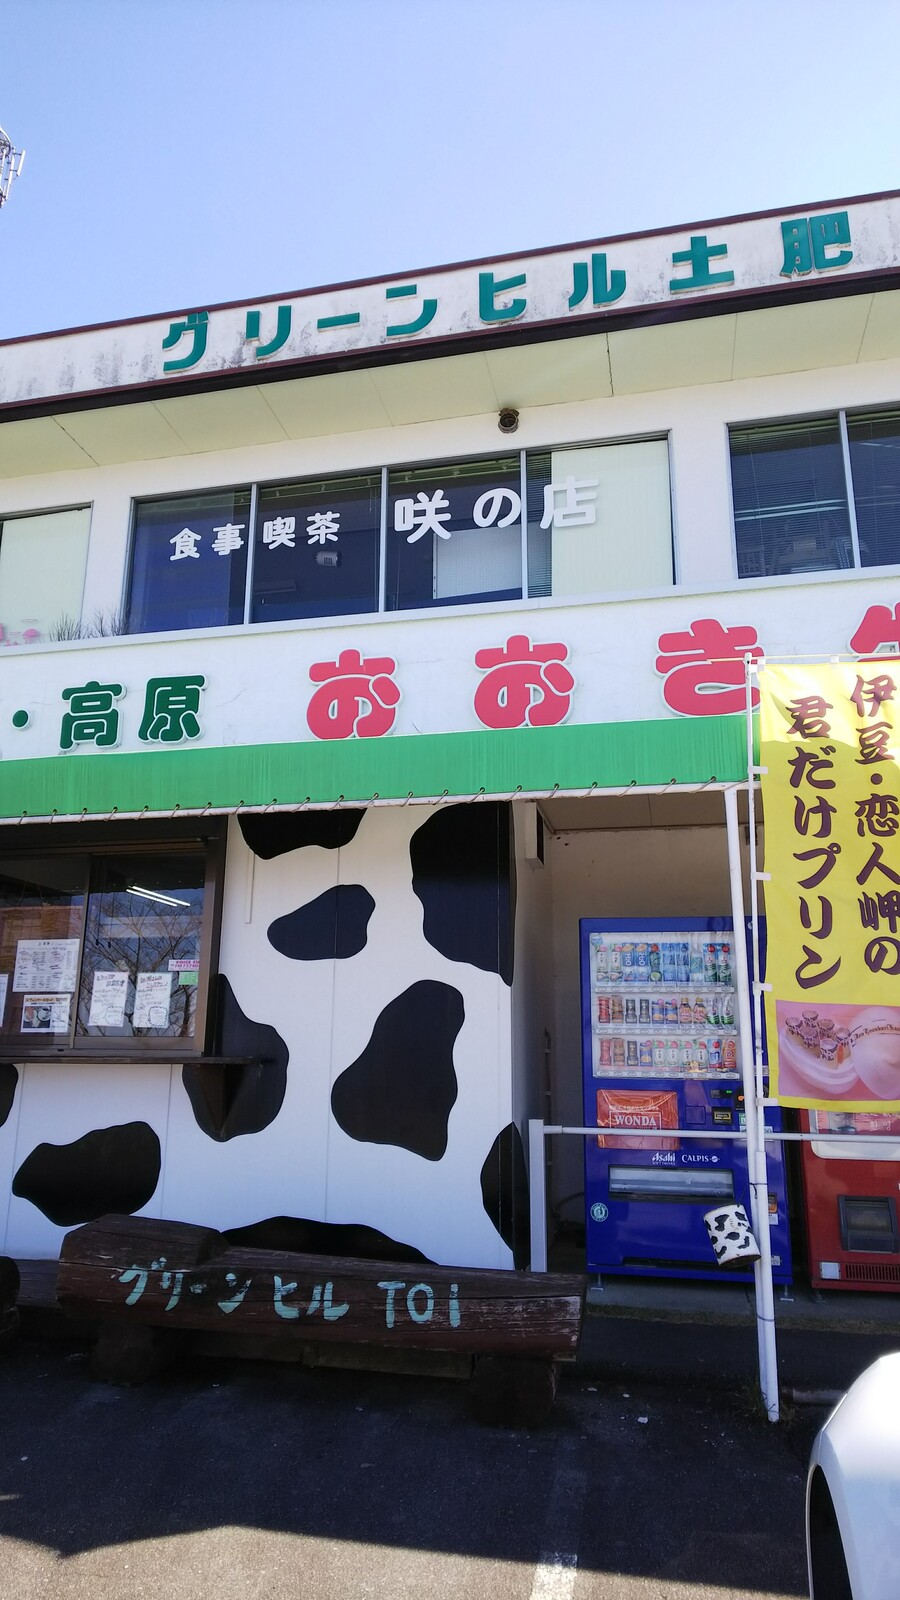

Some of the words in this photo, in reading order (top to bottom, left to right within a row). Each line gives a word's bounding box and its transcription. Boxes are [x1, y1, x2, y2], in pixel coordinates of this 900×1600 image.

[162, 211, 853, 371] グリーンヒル土肥
[394, 475, 599, 544] 咲の店
[306, 604, 900, 740] おおき
[785, 696, 843, 990] 君だけプリン
[849, 674, 900, 976] 伊豆・恋人岬の
[614, 1114, 657, 1126] WONDA
[651, 1151, 676, 1163] Asahi
[681, 1154, 709, 1164] CALPIS
